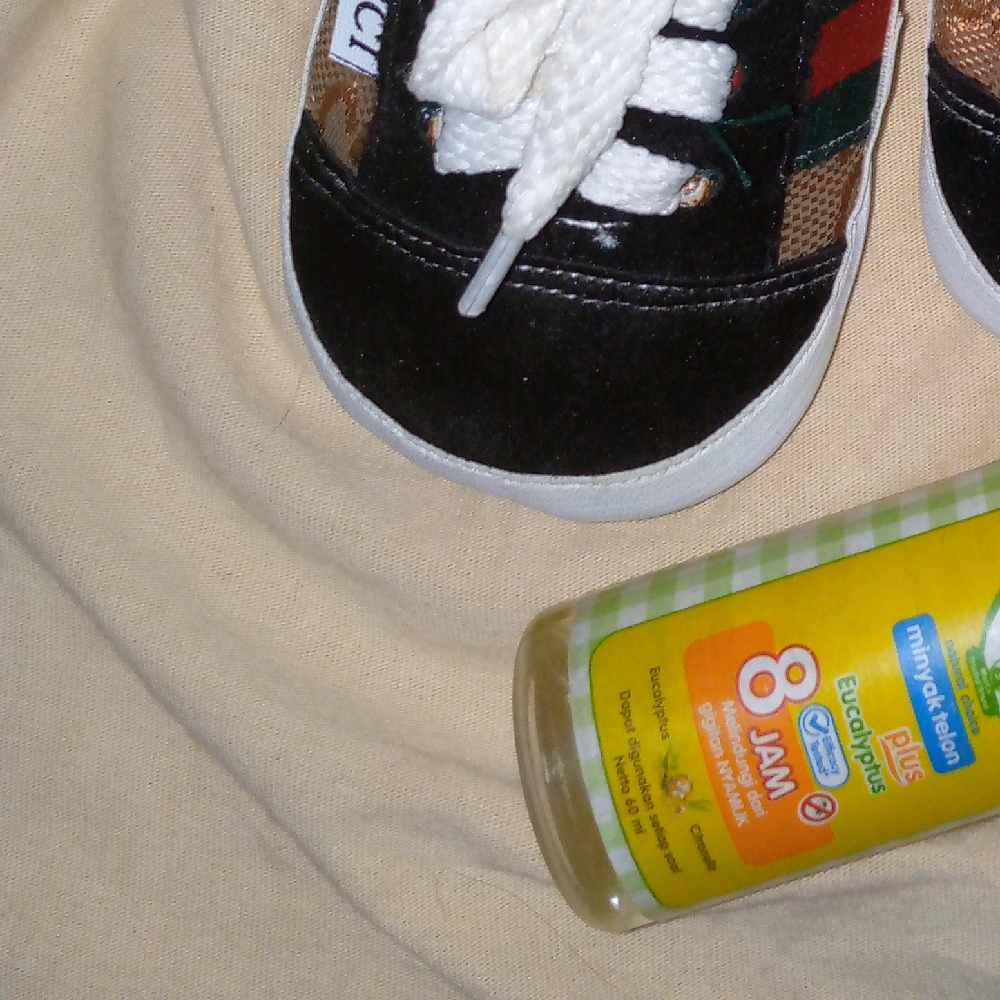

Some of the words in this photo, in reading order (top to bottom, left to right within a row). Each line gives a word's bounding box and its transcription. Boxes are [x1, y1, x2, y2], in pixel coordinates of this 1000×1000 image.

[650, 666, 670, 741] Eucalyptus
[736, 643, 820, 718] 8
[906, 623, 943, 713] minyak
[931, 710, 961, 766] telon
[619, 689, 636, 734] Dapat
[628, 737, 654, 812] digunakan
[722, 700, 758, 787] Melindungi
[747, 790, 768, 818] dari
[747, 726, 799, 801] JAM
[838, 675, 887, 794] Eucalyptus
[885, 730, 925, 784] plus
[613, 755, 631, 795] Netto
[625, 799, 639, 816] 60
[716, 760, 749, 827] NYAMUK
[631, 819, 647, 836] ml
